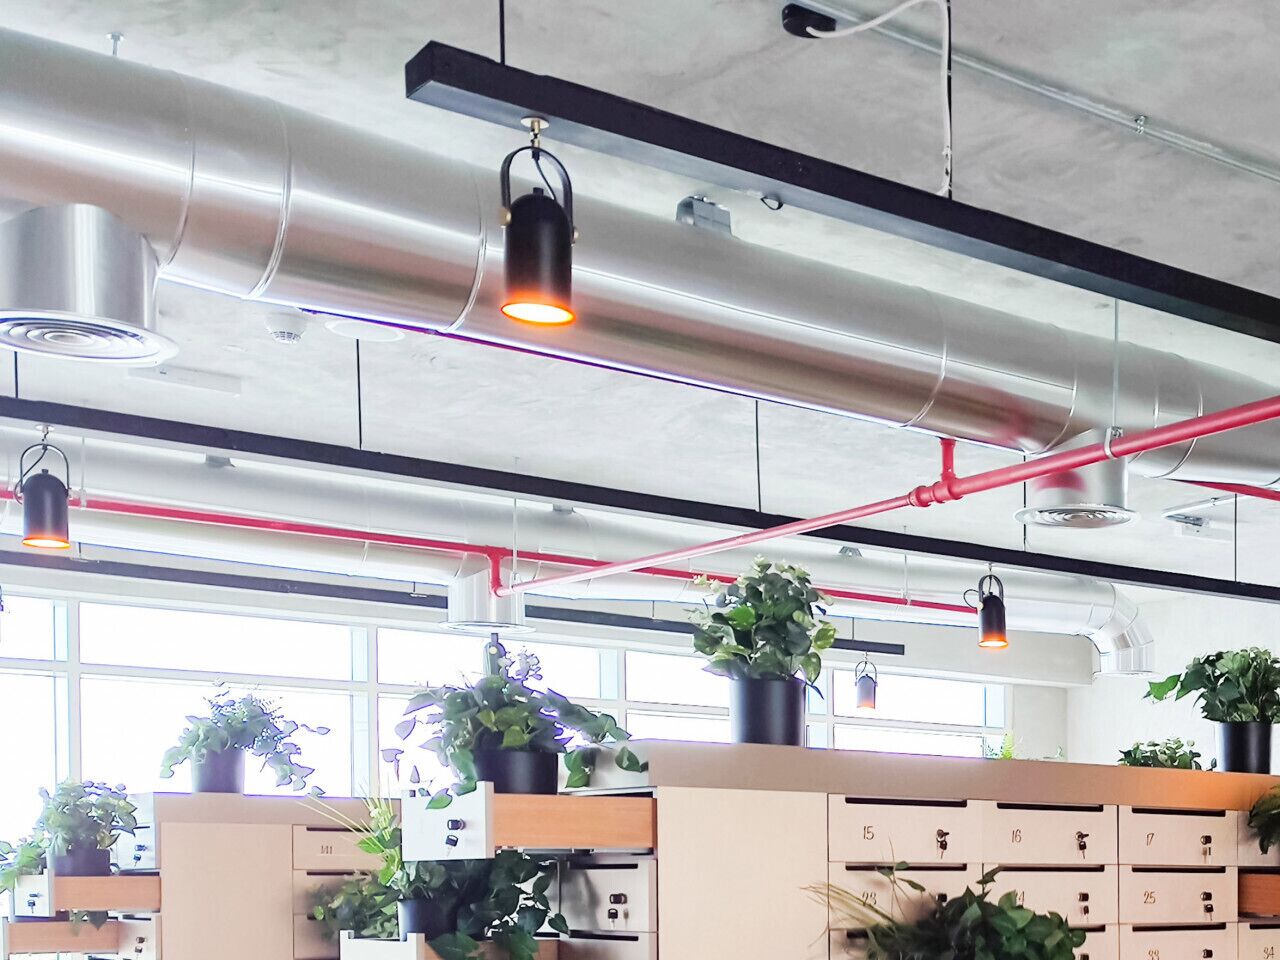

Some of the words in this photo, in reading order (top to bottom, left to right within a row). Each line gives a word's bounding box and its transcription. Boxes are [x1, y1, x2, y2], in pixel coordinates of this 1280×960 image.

[863, 825, 875, 841] 15
[1011, 828, 1022, 844] 16
[1146, 832, 1155, 847] 17
[1143, 890, 1156, 905] 25
[1263, 945, 1276, 960] 34
